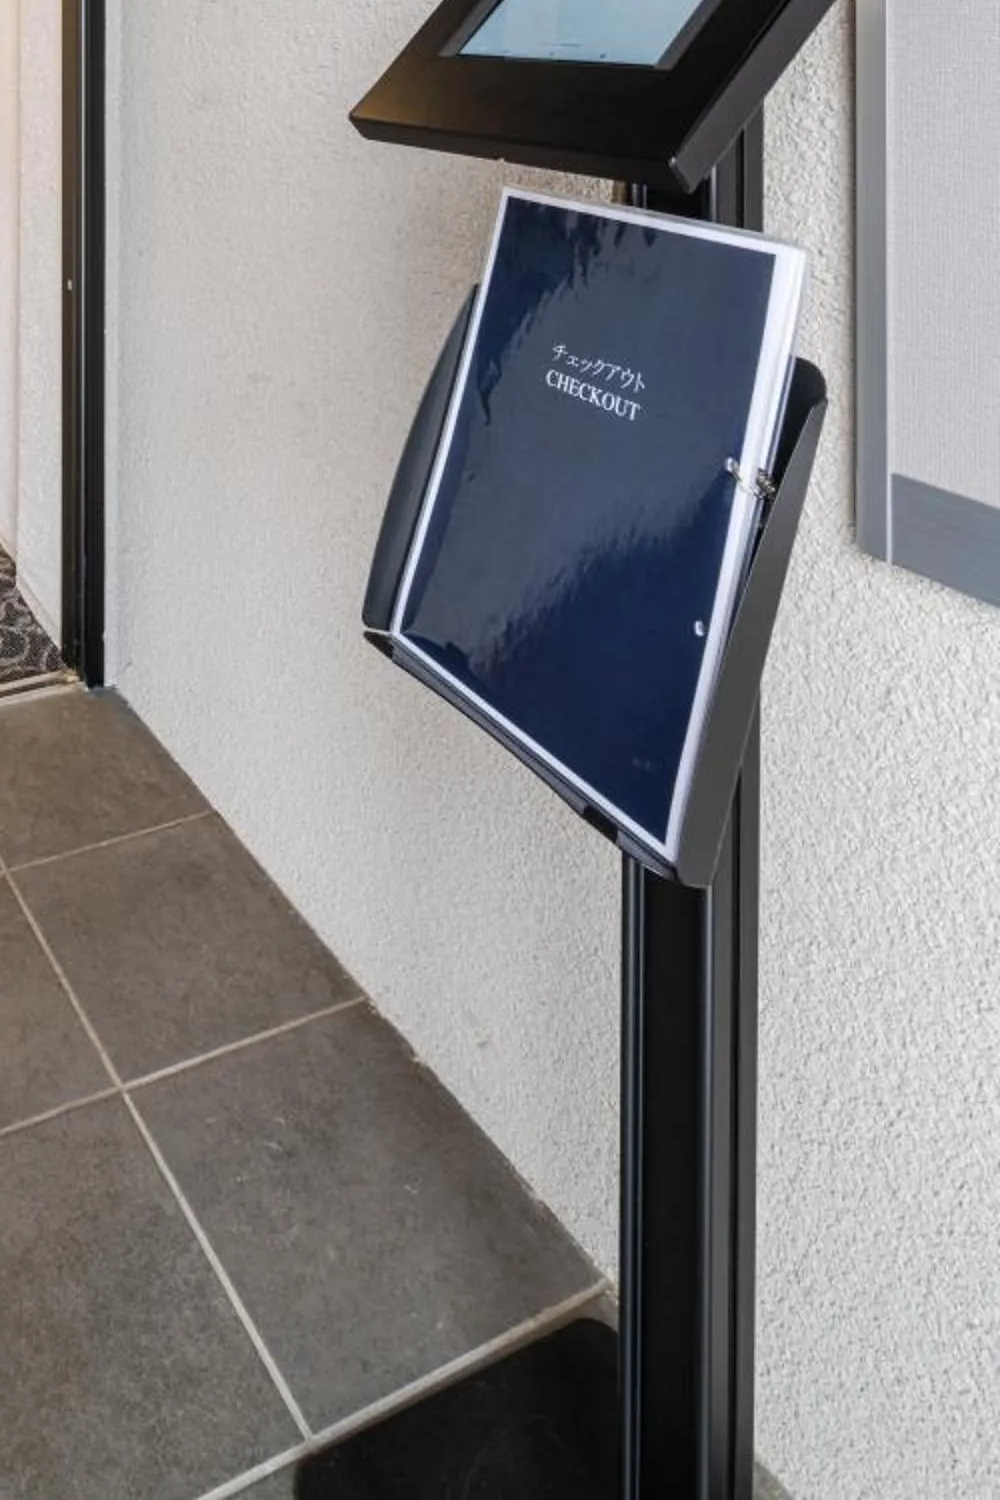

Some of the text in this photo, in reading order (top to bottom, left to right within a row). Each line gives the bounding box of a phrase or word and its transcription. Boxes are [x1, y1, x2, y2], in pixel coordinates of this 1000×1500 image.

[552, 344, 646, 393] チェックアウト
[545, 369, 641, 421] CHECKOUT
